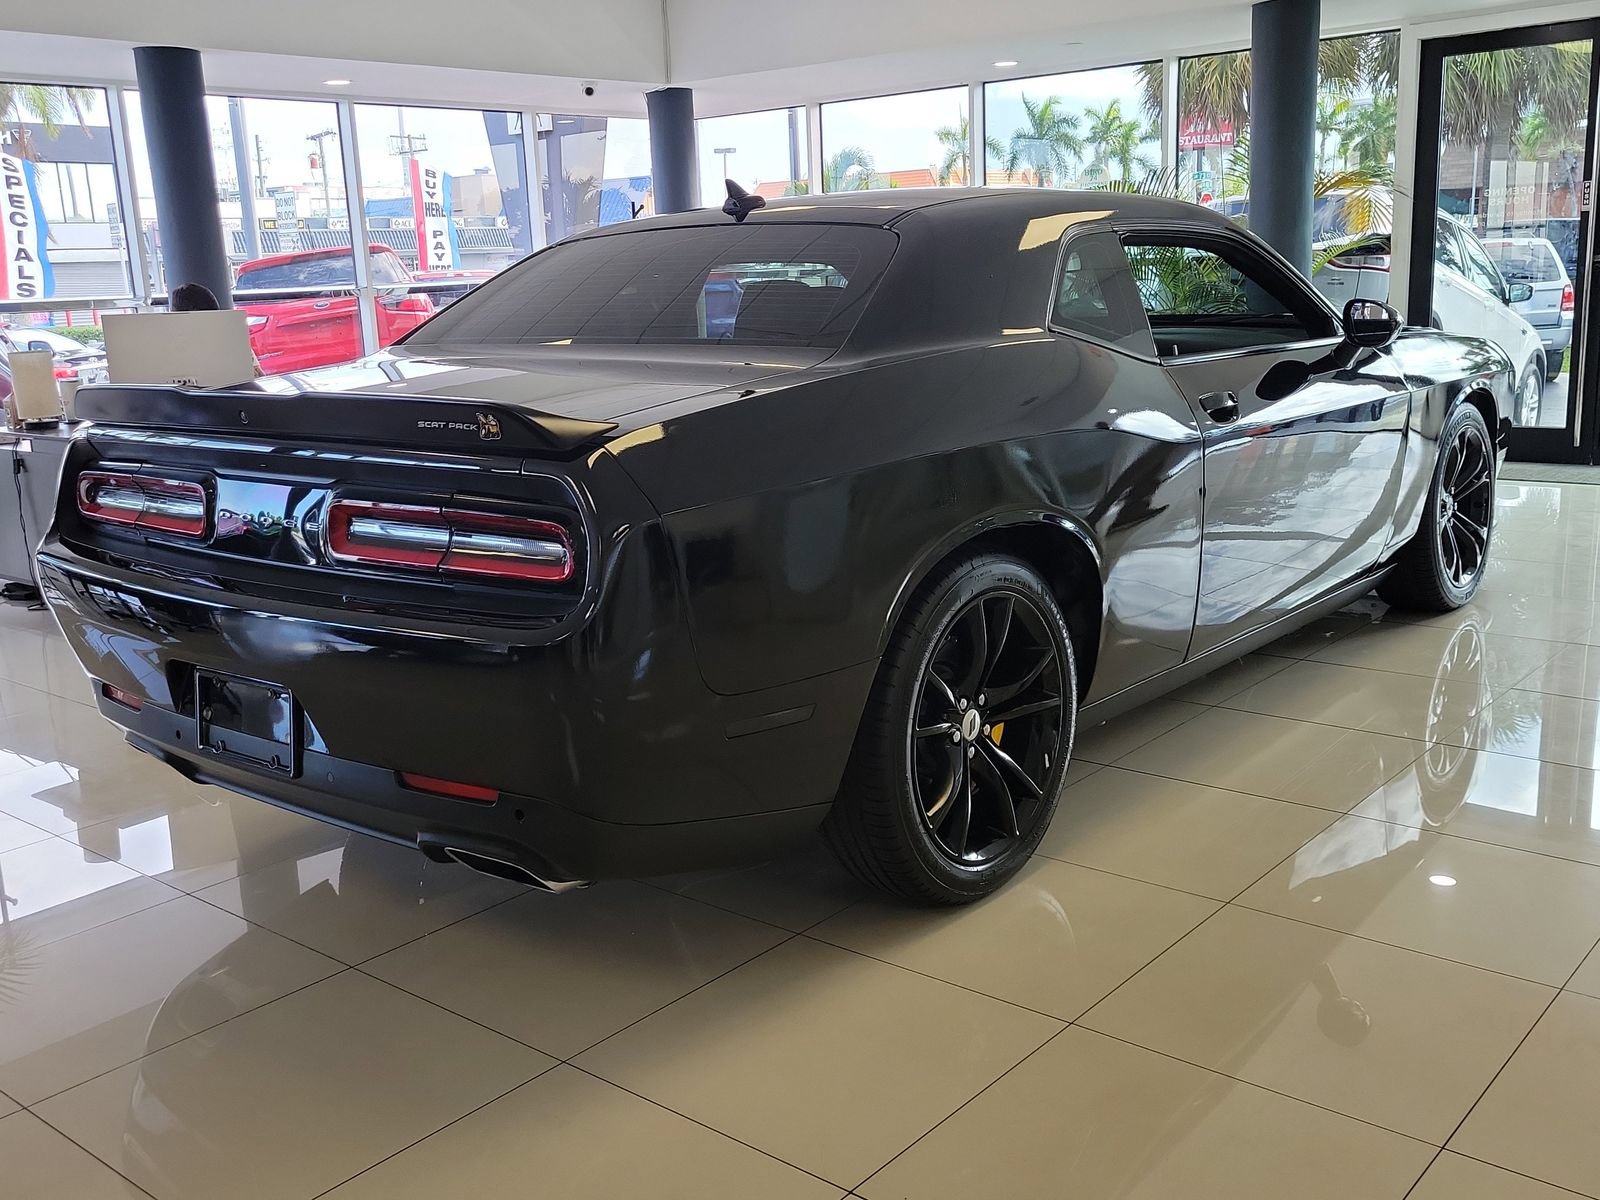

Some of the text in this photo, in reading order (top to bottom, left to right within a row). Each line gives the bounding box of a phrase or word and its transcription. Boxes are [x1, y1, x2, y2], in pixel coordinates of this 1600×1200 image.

[1179, 133, 1232, 146] STAURANT
[425, 168, 437, 199] BUY
[276, 196, 294, 208] DO NOT
[277, 211, 295, 221] BLOCK
[425, 202, 446, 217] HERE
[1, 157, 37, 299] SPECIALS
[433, 230, 445, 261] PAY
[417, 420, 478, 431] SCAT PACK
